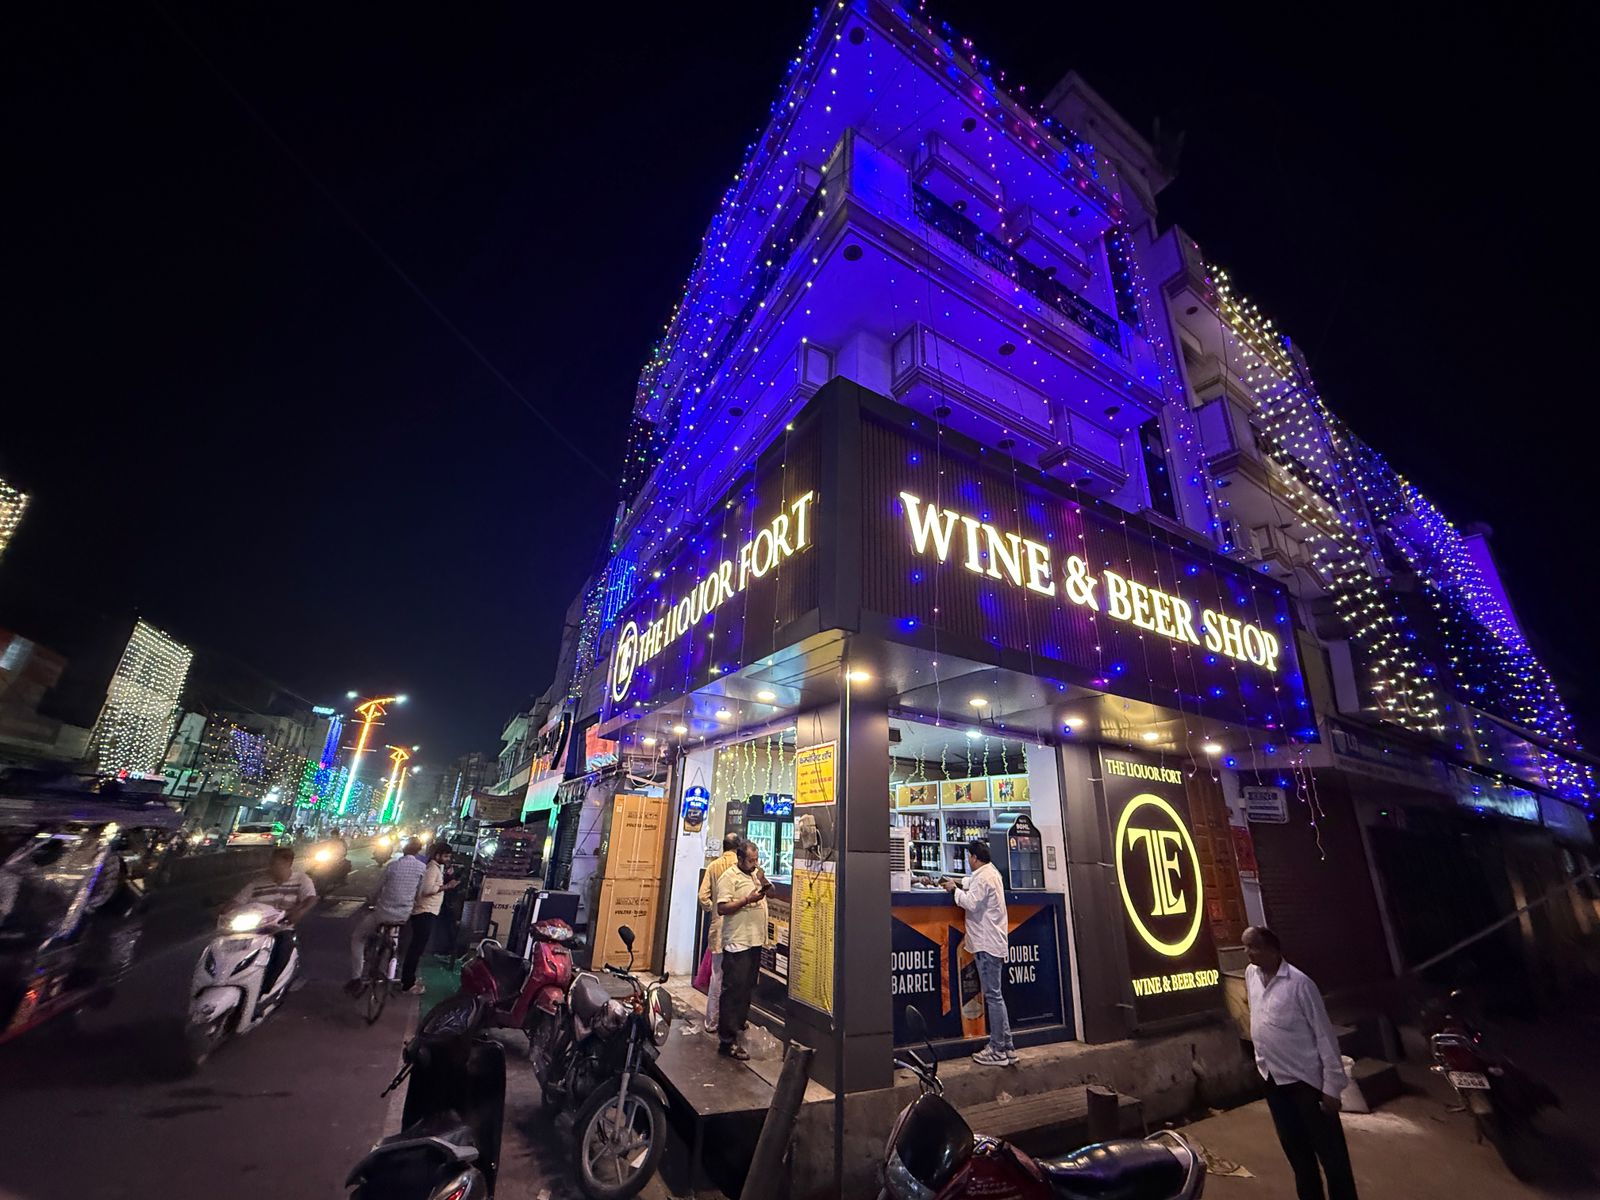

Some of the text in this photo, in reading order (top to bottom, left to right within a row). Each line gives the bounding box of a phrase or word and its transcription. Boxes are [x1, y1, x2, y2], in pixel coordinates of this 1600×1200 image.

[638, 490, 813, 667] THE LIQUOR FORT
[900, 491, 1278, 672] WINE & BEER SHOP
[1105, 759, 1182, 784] THE LIQUOR FORT
[891, 950, 934, 972] DOUBLE
[891, 973, 935, 995] BARREL
[1008, 965, 1036, 984] SWAG
[1132, 969, 1219, 997] WINE & BEER SHOP
